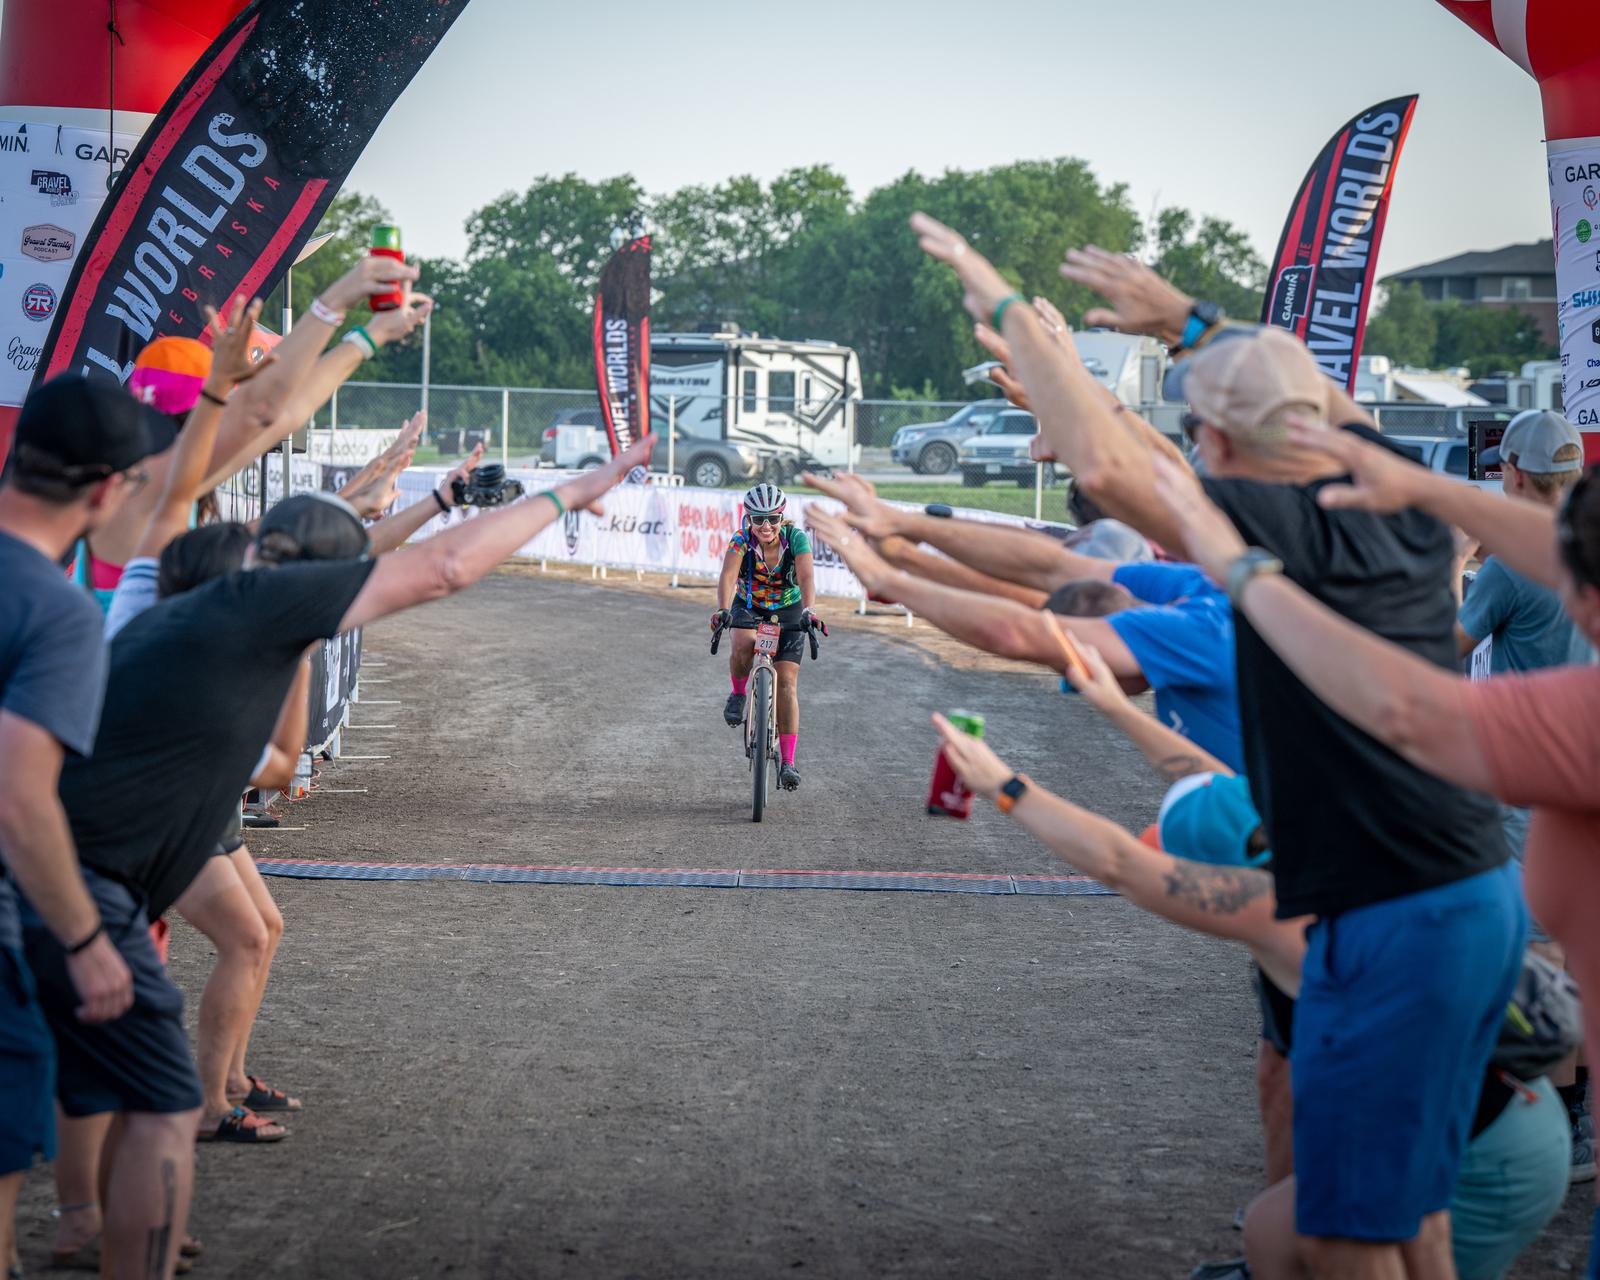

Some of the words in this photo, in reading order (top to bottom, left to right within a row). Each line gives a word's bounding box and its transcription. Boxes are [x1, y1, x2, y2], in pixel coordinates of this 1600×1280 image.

[37, 176, 69, 189] GRAVEL
[1321, 111, 1400, 269] WORLDS
[33, 246, 59, 254] PODCAST
[105, 112, 268, 342] WORLDS
[1282, 273, 1300, 321] GARMIN
[7, 336, 43, 359] Grave
[605, 319, 629, 393] WORLDS
[1305, 282, 1362, 391] AVEL
[760, 639, 773, 649] 217
